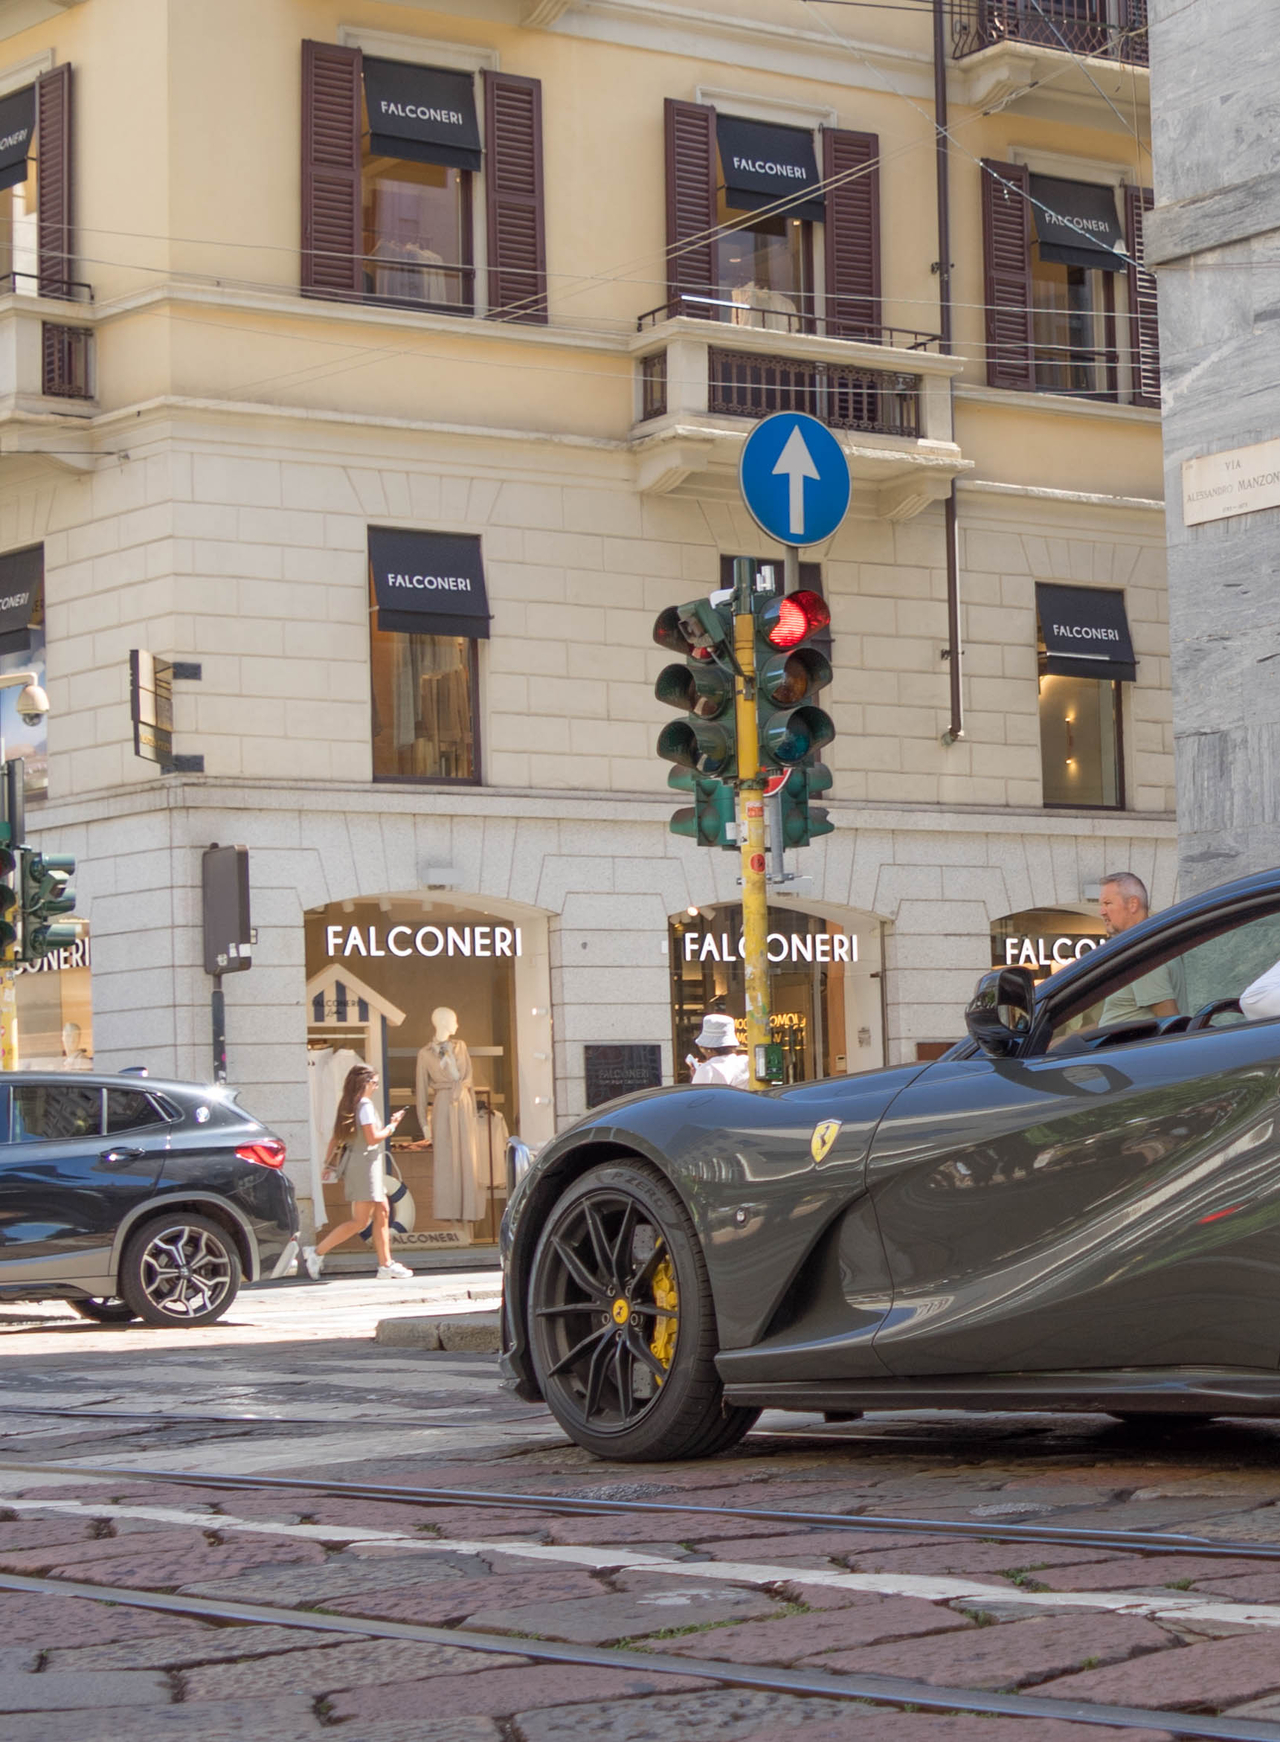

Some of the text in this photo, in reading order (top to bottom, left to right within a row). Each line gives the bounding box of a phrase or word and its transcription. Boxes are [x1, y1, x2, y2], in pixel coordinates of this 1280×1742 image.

[380, 101, 463, 125] FALCONERI
[733, 157, 806, 179] FALCONERI
[1045, 213, 1109, 232] FALCONERI
[1225, 460, 1241, 470] VIA
[1187, 484, 1233, 503] ALESSANDRO
[387, 573, 471, 591] FALCONERI
[0, 592, 29, 610] ONERI
[1053, 624, 1119, 641] FALCONERI
[326, 925, 523, 957] FALCONERI
[684, 932, 859, 962] FALONERI
[1005, 937, 1106, 966] FALCO
[392, 1232, 460, 1245] ALCONERI
